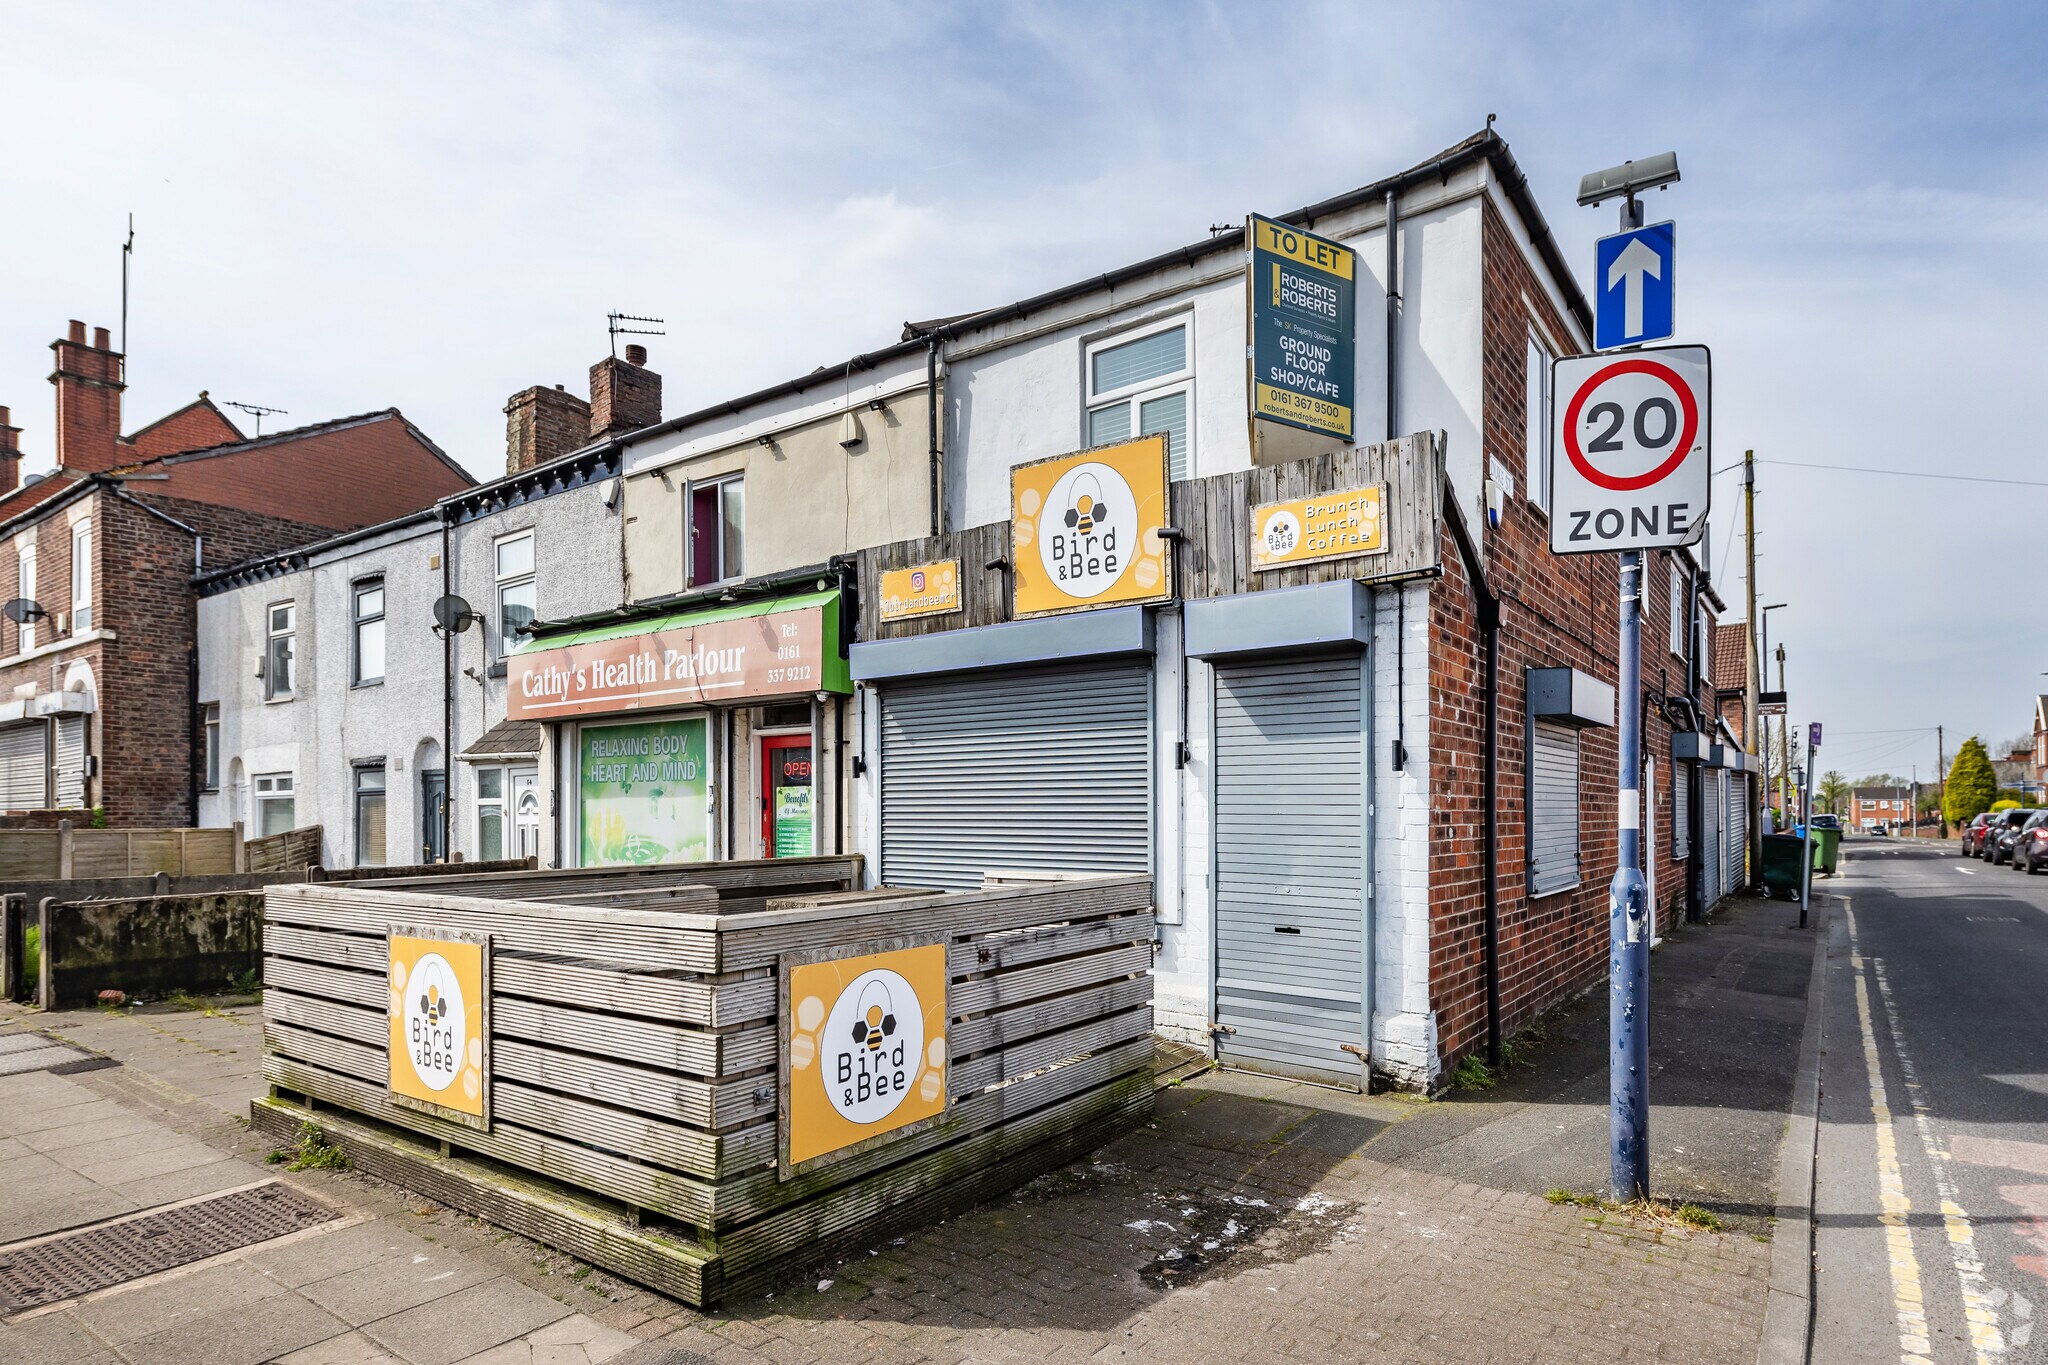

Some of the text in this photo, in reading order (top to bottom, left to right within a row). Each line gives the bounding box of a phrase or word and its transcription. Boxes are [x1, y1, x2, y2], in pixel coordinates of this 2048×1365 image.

[1270, 226, 1341, 270] TO LET
[1281, 272, 1337, 302] ROBERTS
[1281, 287, 1337, 317] ROBERTS
[1273, 317, 1337, 345] The SK Property Specialists
[1279, 335, 1331, 362] GROUND
[1285, 351, 1326, 376] FLOOR
[1270, 366, 1339, 398] SHOP/CAFE
[1263, 403, 1345, 431] robertsandroberts.co.uk
[1270, 389, 1339, 418] 0161 367 9500
[1586, 397, 1677, 453] 20
[1305, 497, 1369, 518] Brunch
[1306, 516, 1358, 534] Lunch
[1569, 503, 1689, 542] ZONE
[1053, 526, 1116, 561] Bird
[1268, 532, 1293, 544] Bird
[1307, 533, 1370, 550] Coffee
[781, 622, 798, 638] Tel:
[777, 645, 801, 660] 0161
[522, 643, 746, 702] Cathy's Health Parlour
[767, 665, 811, 684] 337 9212
[591, 734, 687, 758] RELAXING BODY
[591, 760, 697, 783] HEART AND MIND
[784, 792, 809, 807] Benefits
[413, 1017, 452, 1050] Bird
[838, 1039, 904, 1084] Bird
